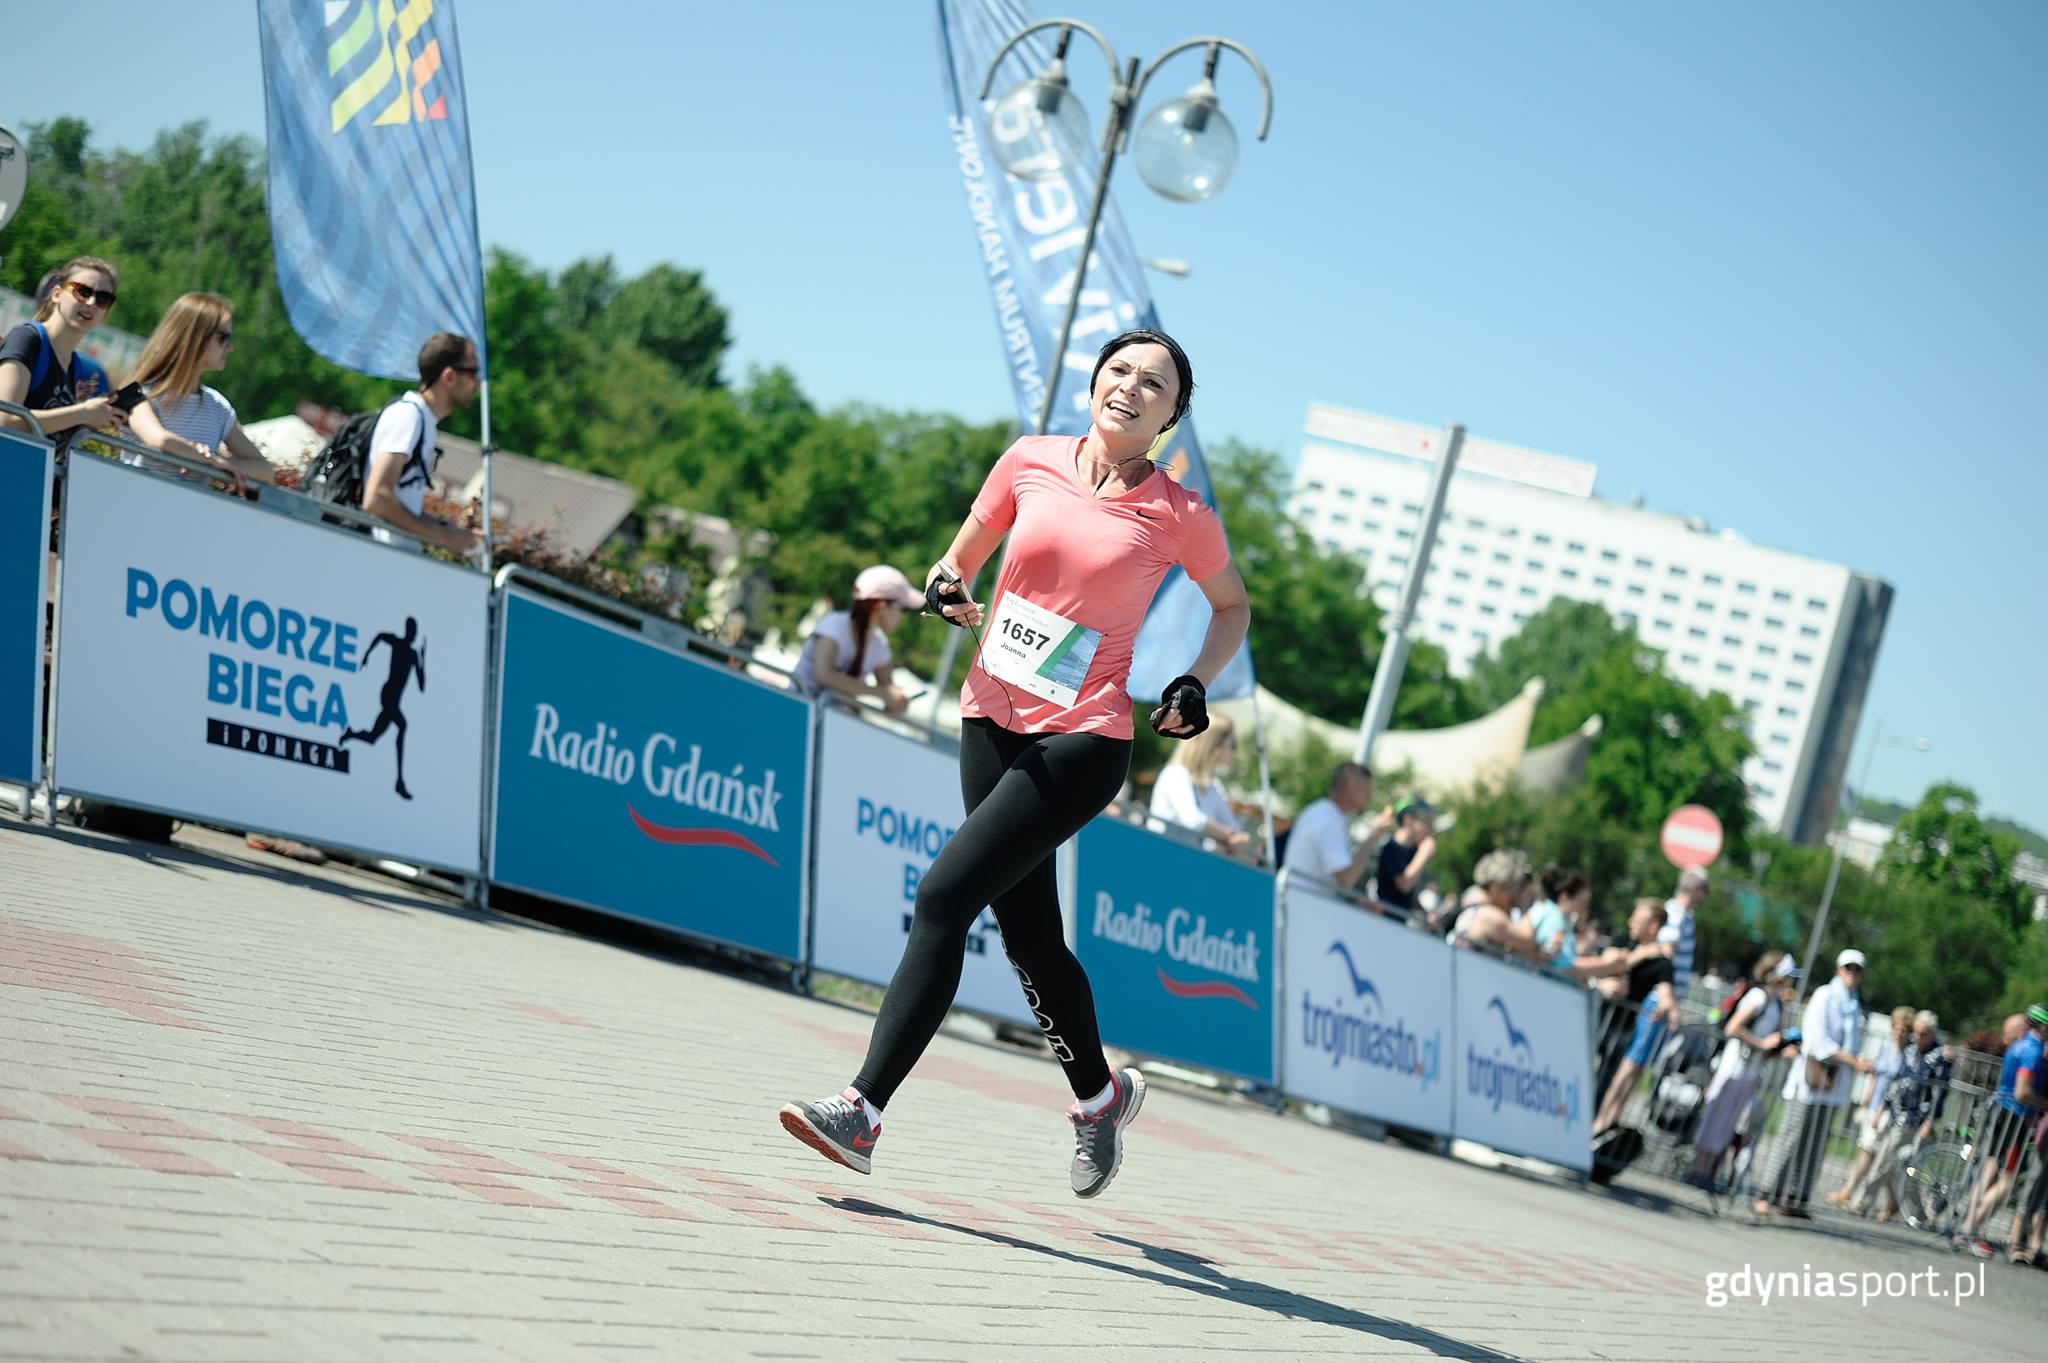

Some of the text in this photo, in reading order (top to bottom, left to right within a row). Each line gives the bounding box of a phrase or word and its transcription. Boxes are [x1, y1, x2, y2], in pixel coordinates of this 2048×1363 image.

[126, 566, 358, 673] POMORZE
[1000, 642, 1026, 659] Joanna
[1002, 618, 1050, 651] 1657
[207, 653, 348, 731] BIEGA
[241, 727, 336, 769] POMAGA
[529, 702, 783, 832] Radio Gdańsk
[1092, 890, 1261, 983] Radio Gdańsk
[1303, 989, 1441, 1092] trojmiasto.pl
[1466, 1041, 1579, 1134] trojmiasto.pl
